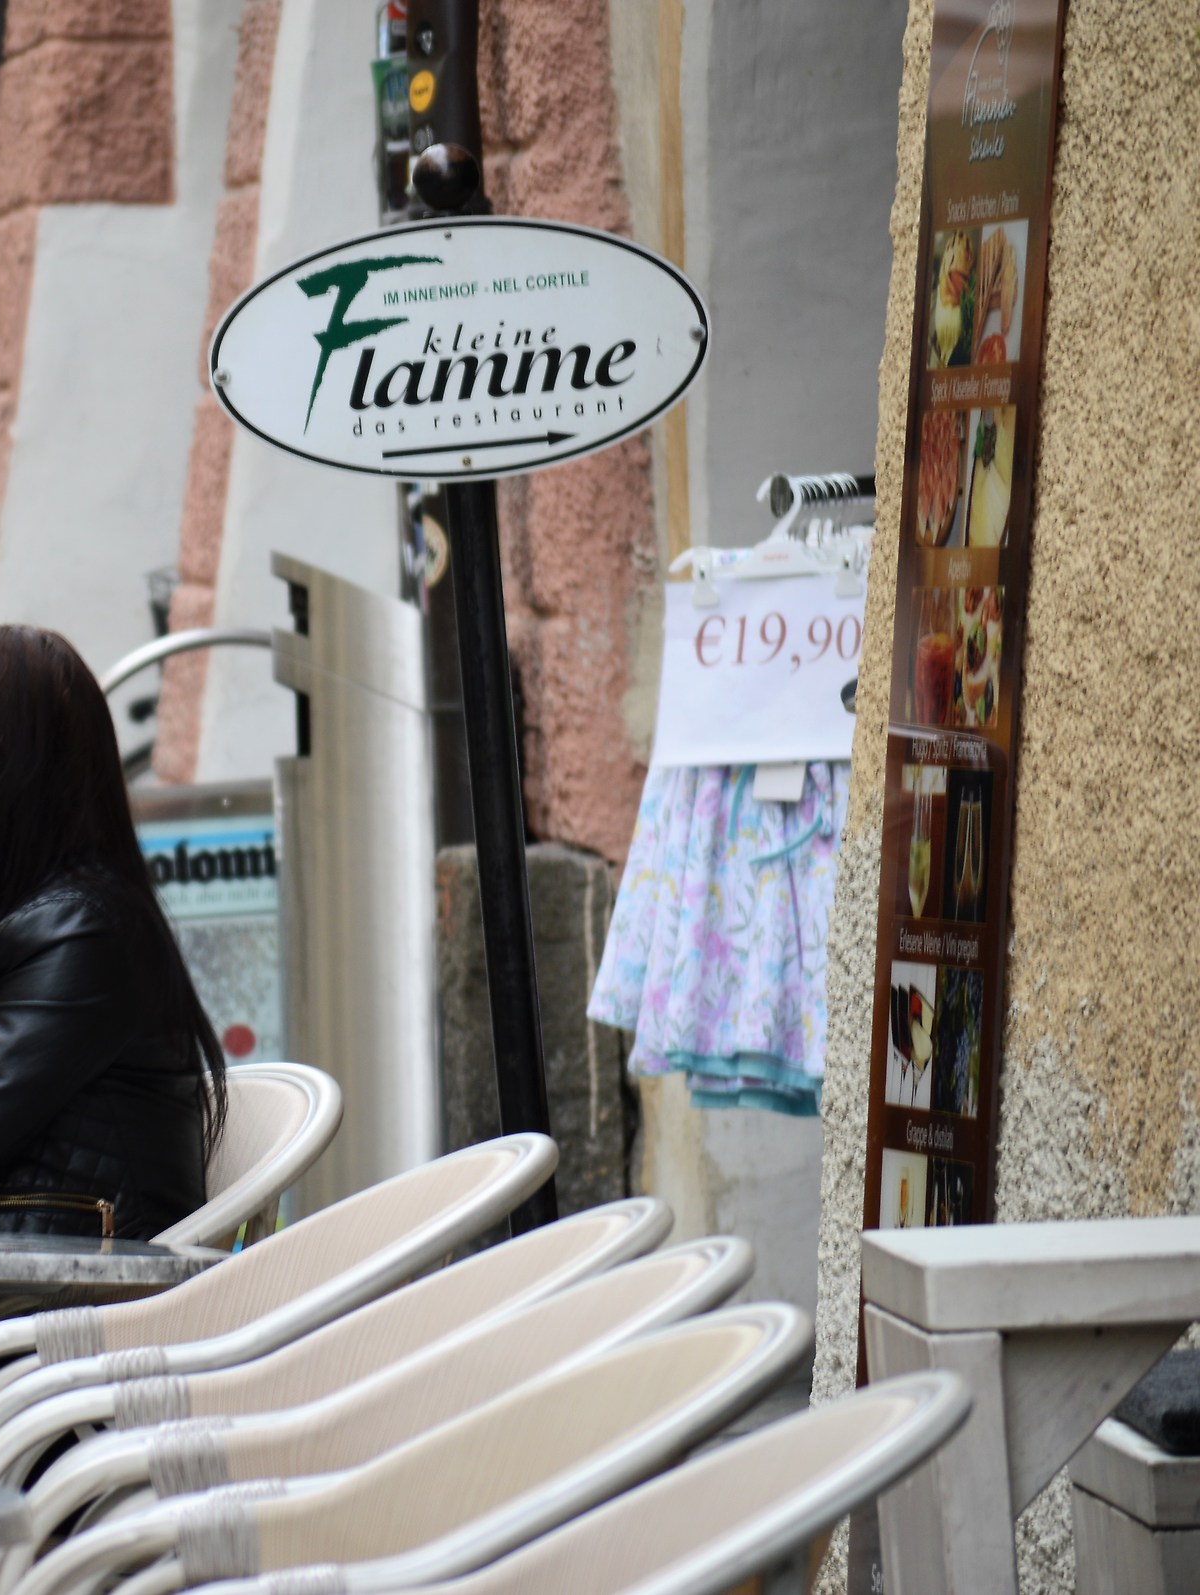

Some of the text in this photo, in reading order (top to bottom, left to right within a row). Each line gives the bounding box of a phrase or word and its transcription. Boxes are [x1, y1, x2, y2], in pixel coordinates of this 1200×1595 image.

[382, 290, 400, 306] IM
[402, 281, 480, 304] INNENHOF
[492, 277, 523, 295] NEL
[525, 269, 590, 292] CORTILE
[294, 254, 637, 436] Flamme
[422, 321, 557, 355] kleine
[352, 395, 626, 437] das restaurant
[694, 611, 862, 675] €19,90
[150, 833, 277, 886] olomi
[923, 930, 942, 956] Weine
[906, 1119, 927, 1152] Grappe
[927, 1122, 934, 1147] &
